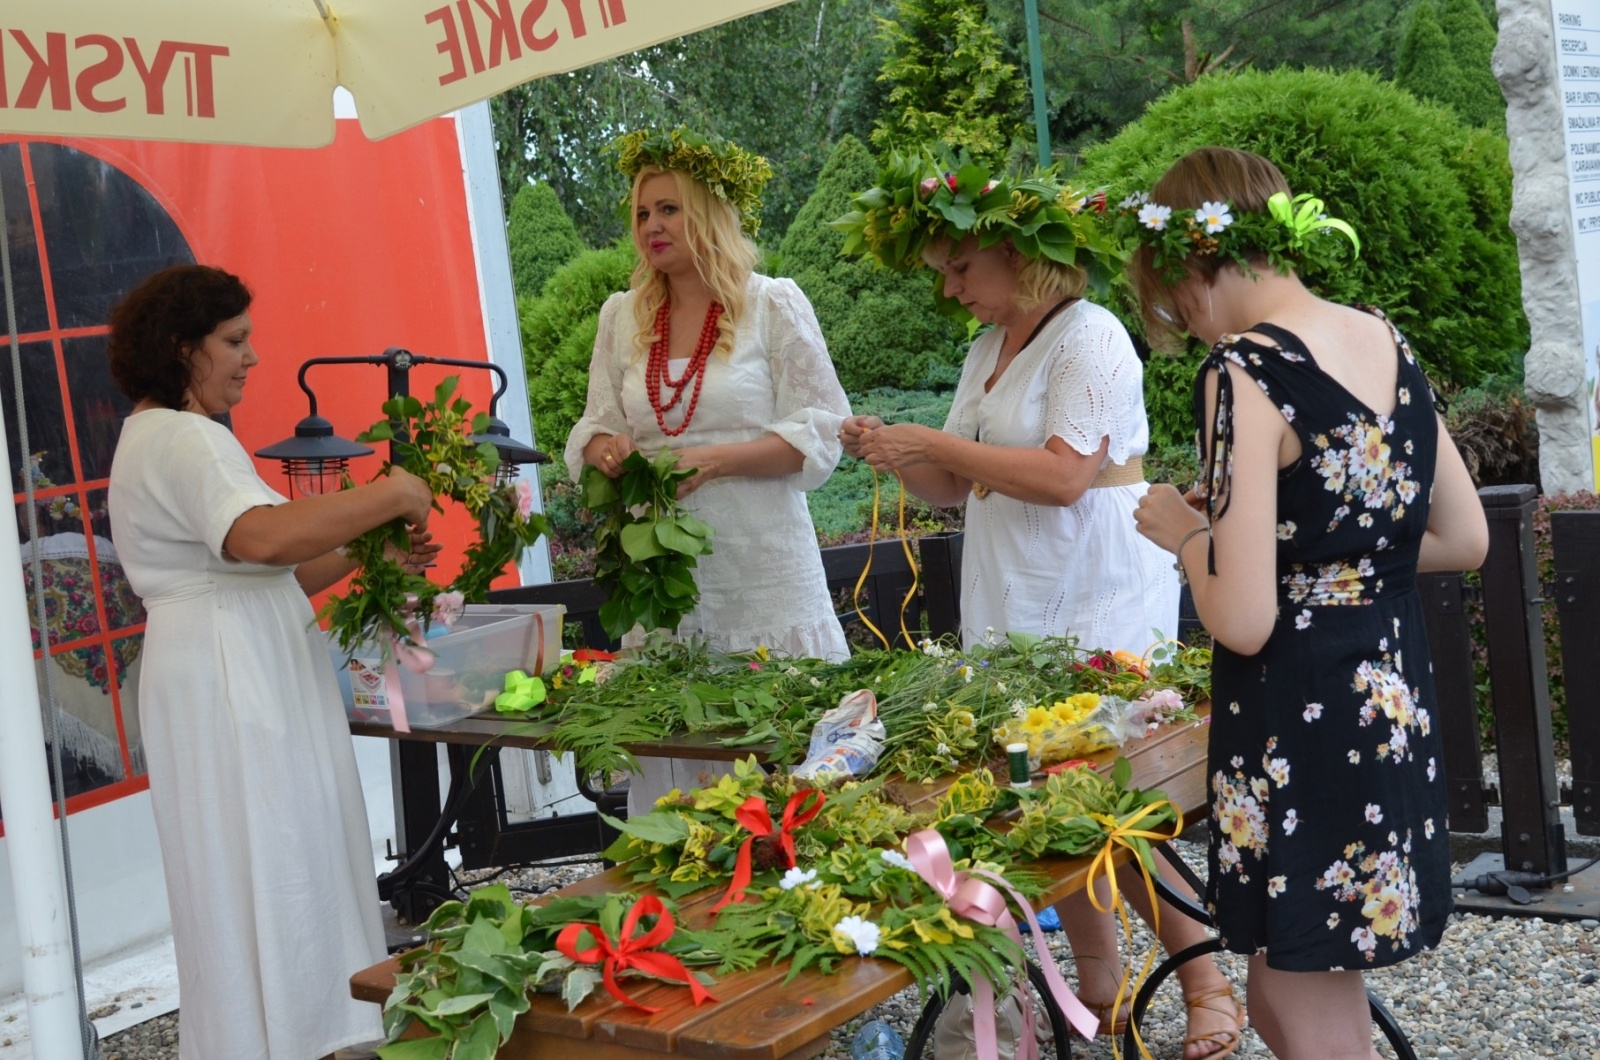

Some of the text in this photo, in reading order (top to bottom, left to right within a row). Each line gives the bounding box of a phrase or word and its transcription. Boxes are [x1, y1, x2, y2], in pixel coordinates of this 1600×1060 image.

[1559, 13, 1581, 27] PARKING
[1561, 39, 1587, 52] RECEPCJA
[1565, 91, 1576, 104] BAR
[1571, 143, 1584, 155] POLE
